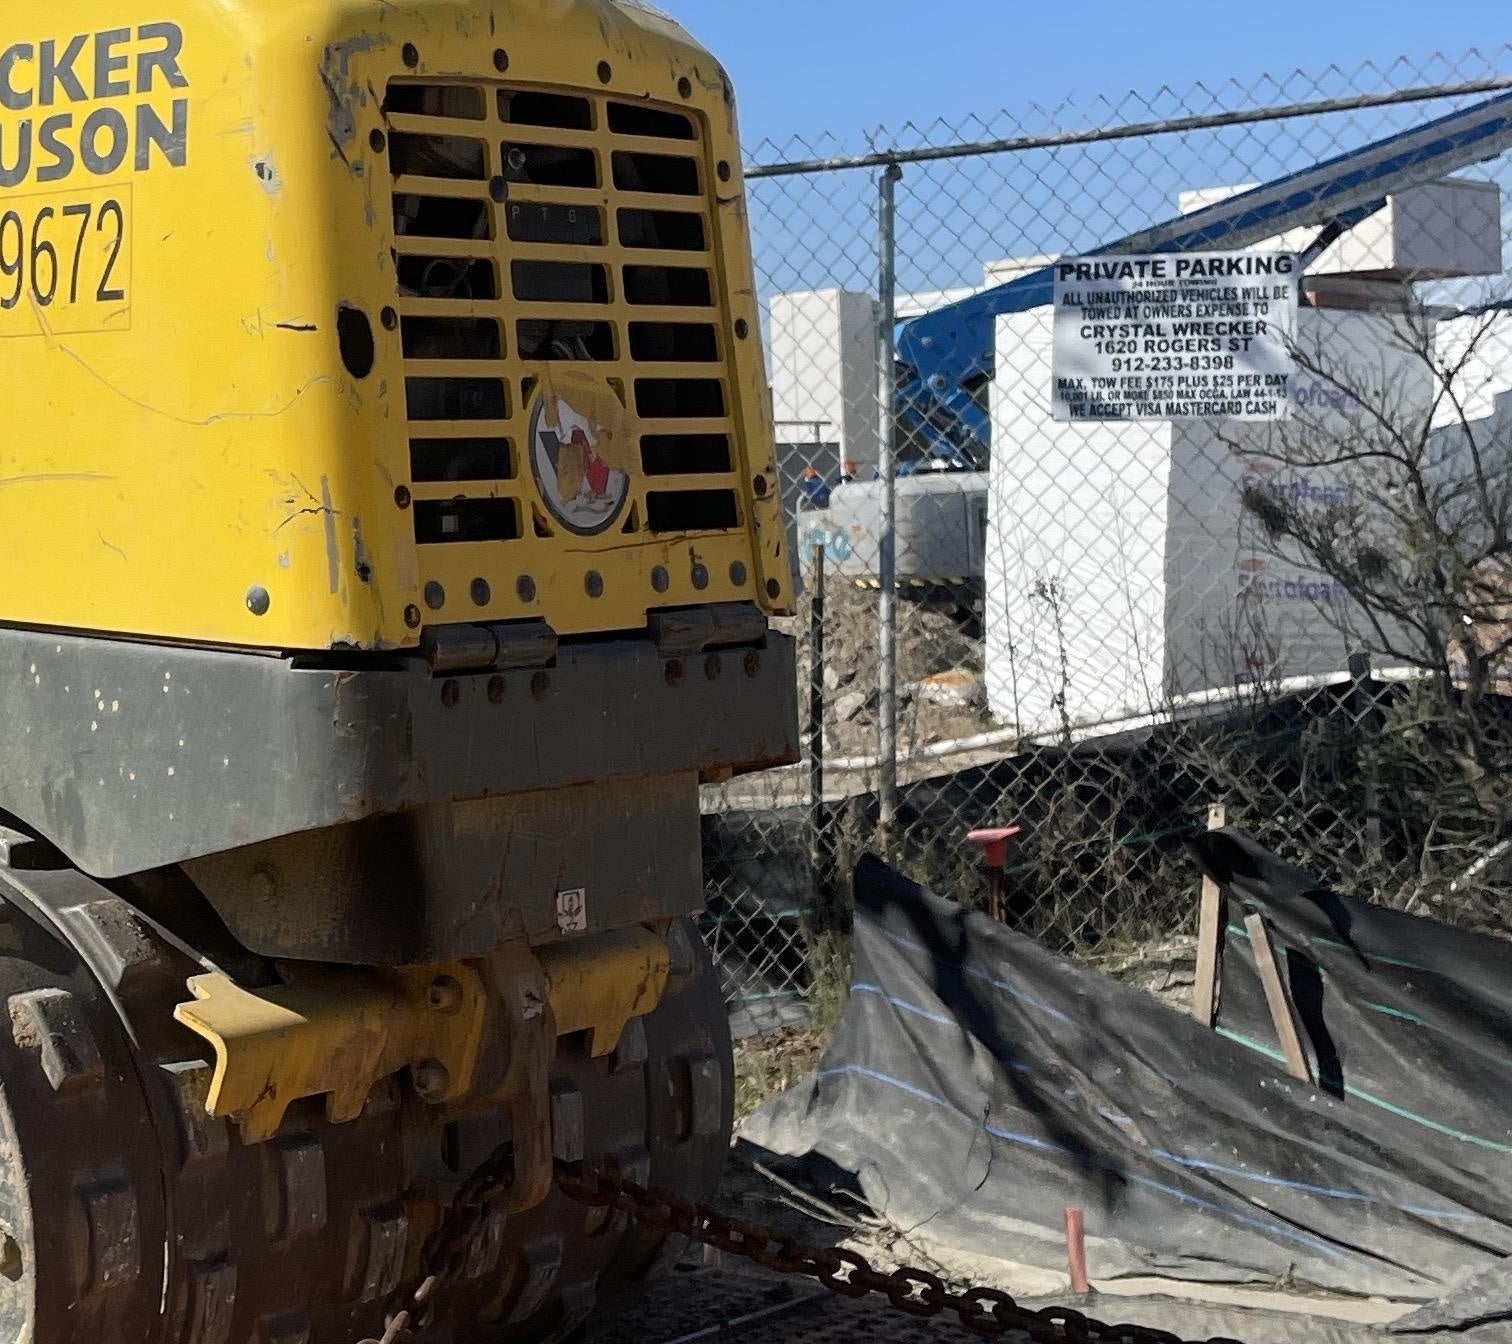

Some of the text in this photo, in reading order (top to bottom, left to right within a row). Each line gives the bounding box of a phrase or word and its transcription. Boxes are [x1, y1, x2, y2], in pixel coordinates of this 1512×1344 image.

[1059, 255, 1293, 281] PRIVATE PARKING
[1063, 285, 1289, 306] ALL UNAUTHORIZED VEHICLES WILL BE
[1081, 302, 1269, 320] TOWED AT OWNERS EXPENSE TO
[1080, 320, 1268, 339] CRYSTAL WRECKER
[1094, 337, 1253, 355] 1620 ROGERS ST
[1112, 355, 1234, 372] 912-233-8398
[1091, 376, 1117, 389] TOW
[1120, 376, 1142, 389] FEE
[1146, 376, 1173, 391] $175
[1177, 376, 1208, 387] PLUS
[1212, 375, 1233, 389] $25
[1238, 374, 1261, 386] PER
[1264, 374, 1288, 387] DAY
[1108, 391, 1121, 401] OR
[1124, 390, 1148, 400] MORE
[1176, 389, 1197, 399] MAX
[1231, 389, 1252, 399] LAW
[1069, 401, 1277, 416] WE ACCEPT VISA MASTERCARD CASH
